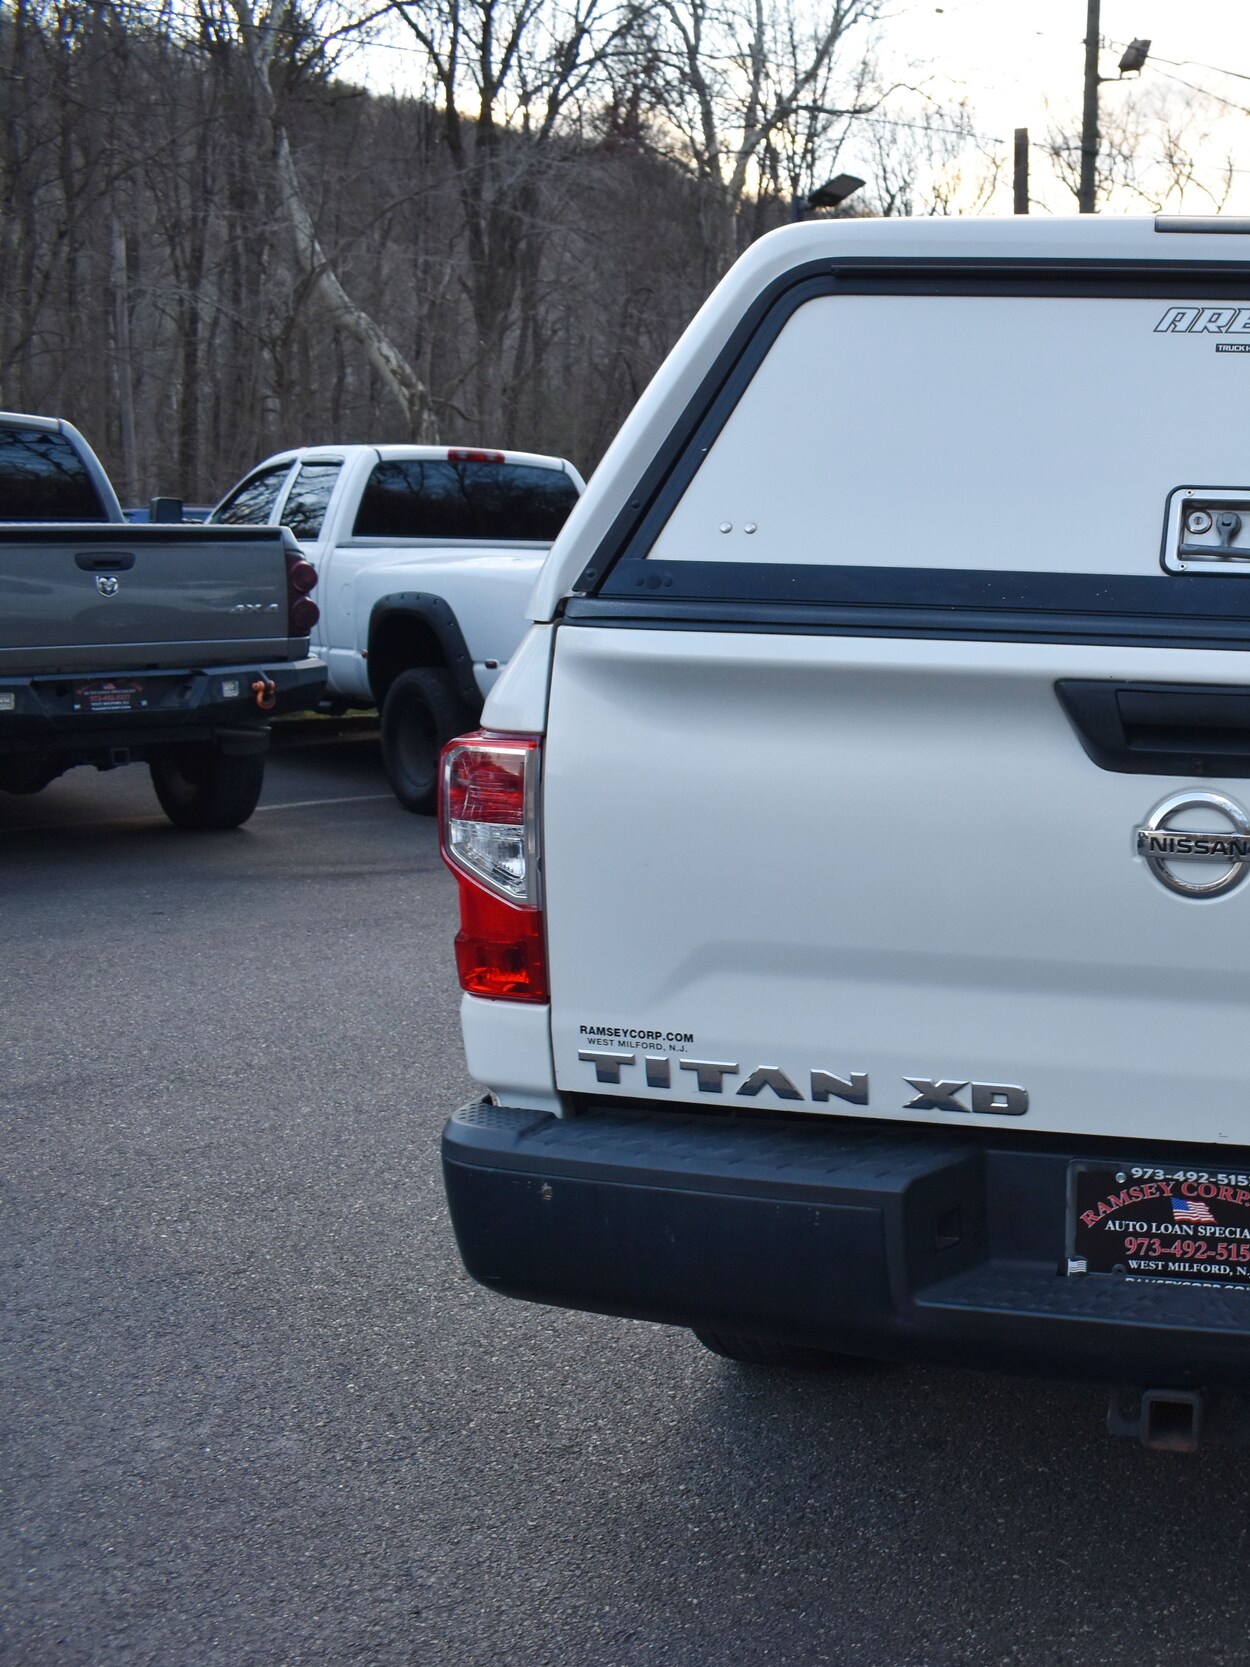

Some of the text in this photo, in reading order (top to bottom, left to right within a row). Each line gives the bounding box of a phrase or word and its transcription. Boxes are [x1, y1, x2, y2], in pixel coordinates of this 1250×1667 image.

[1217, 344, 1246, 352] TRUCK
[1149, 836, 1248, 856] NISSAN
[580, 1025, 694, 1043] RAMSEYCORP.COM
[587, 1037, 688, 1052] WEST MILFORD, N.J.
[577, 1049, 1030, 1116] TITAN XD
[1080, 1181, 1175, 1228] RAMSEY
[1181, 1181, 1250, 1207] CORP.
[1105, 1219, 1148, 1232] AUTO
[1151, 1222, 1194, 1235] LOAN
[1128, 1259, 1165, 1271] WEST
[1167, 1262, 1233, 1277] MILFORD,
